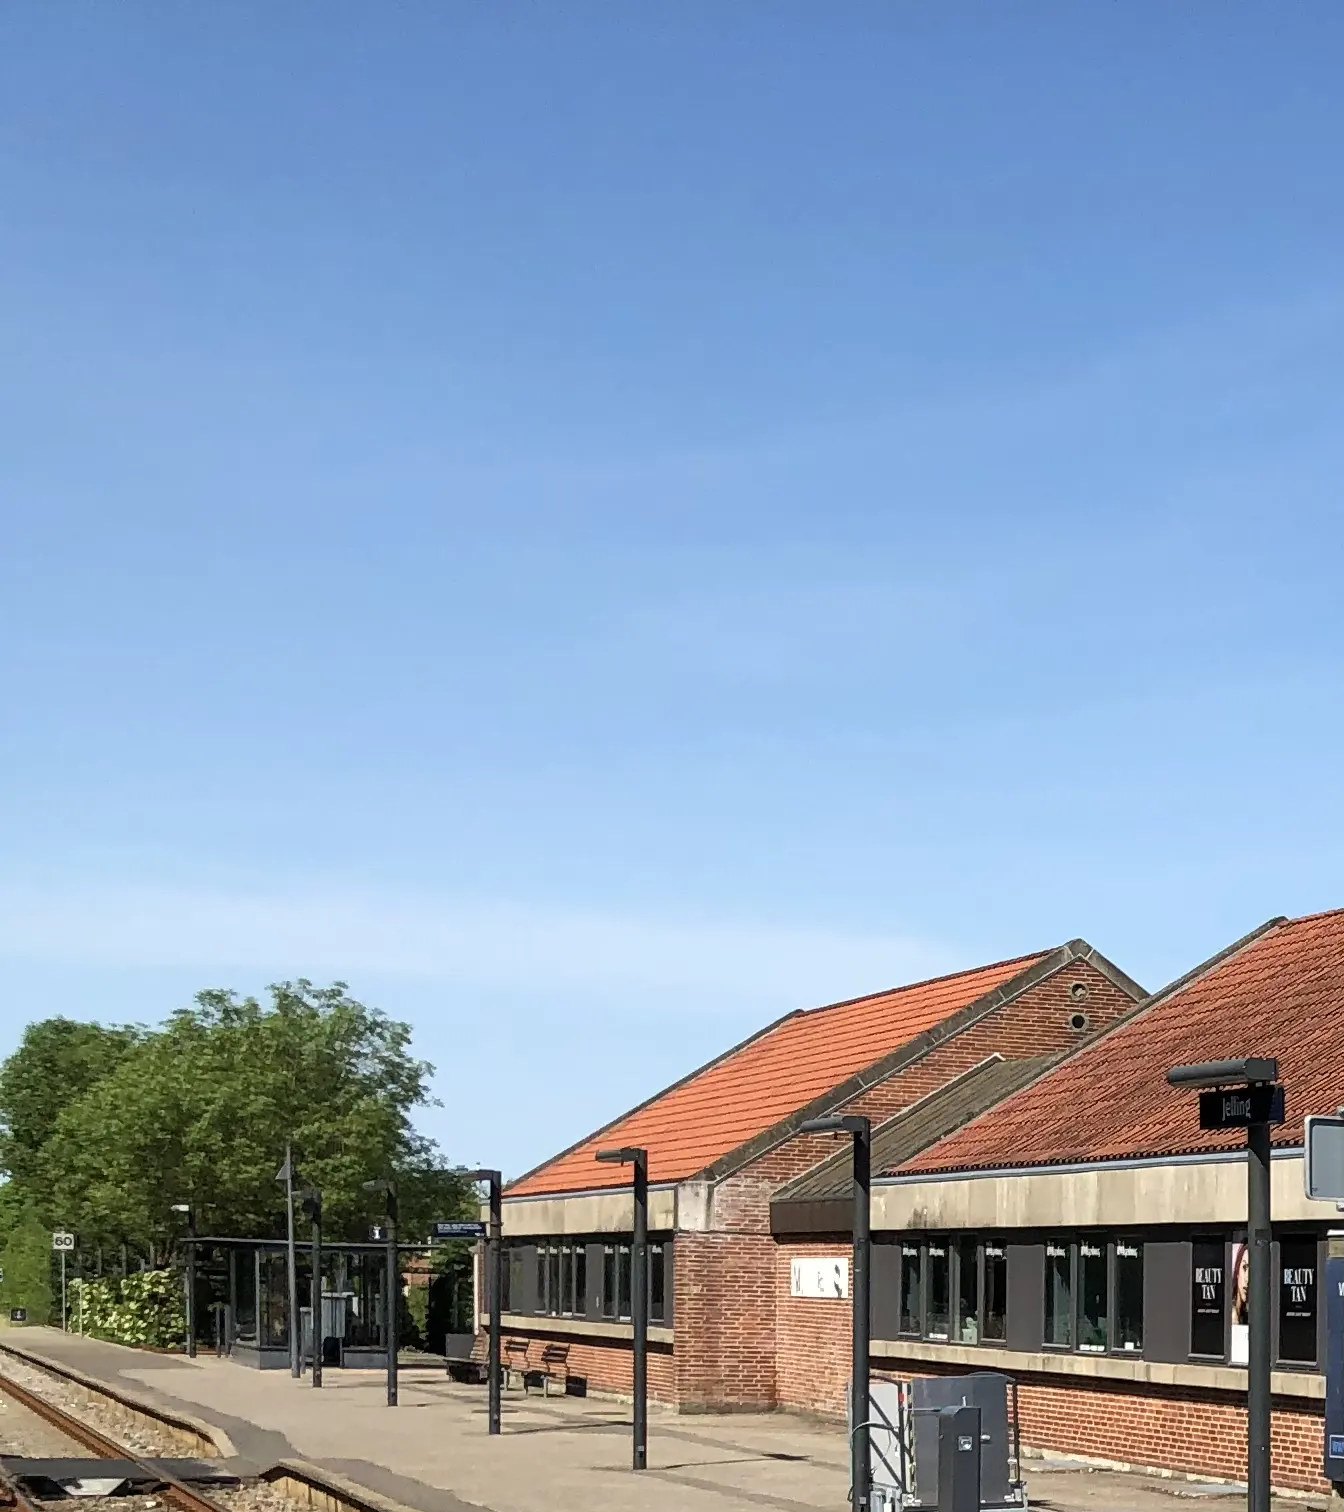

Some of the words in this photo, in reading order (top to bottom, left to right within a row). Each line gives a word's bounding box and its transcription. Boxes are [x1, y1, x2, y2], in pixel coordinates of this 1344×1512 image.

[55, 1236, 72, 1246] 60
[1195, 1268, 1222, 1283] BEAUTY
[1284, 1268, 1314, 1285] BEAUTY
[1202, 1285, 1216, 1300] TAN
[1291, 1285, 1307, 1302] TAN
